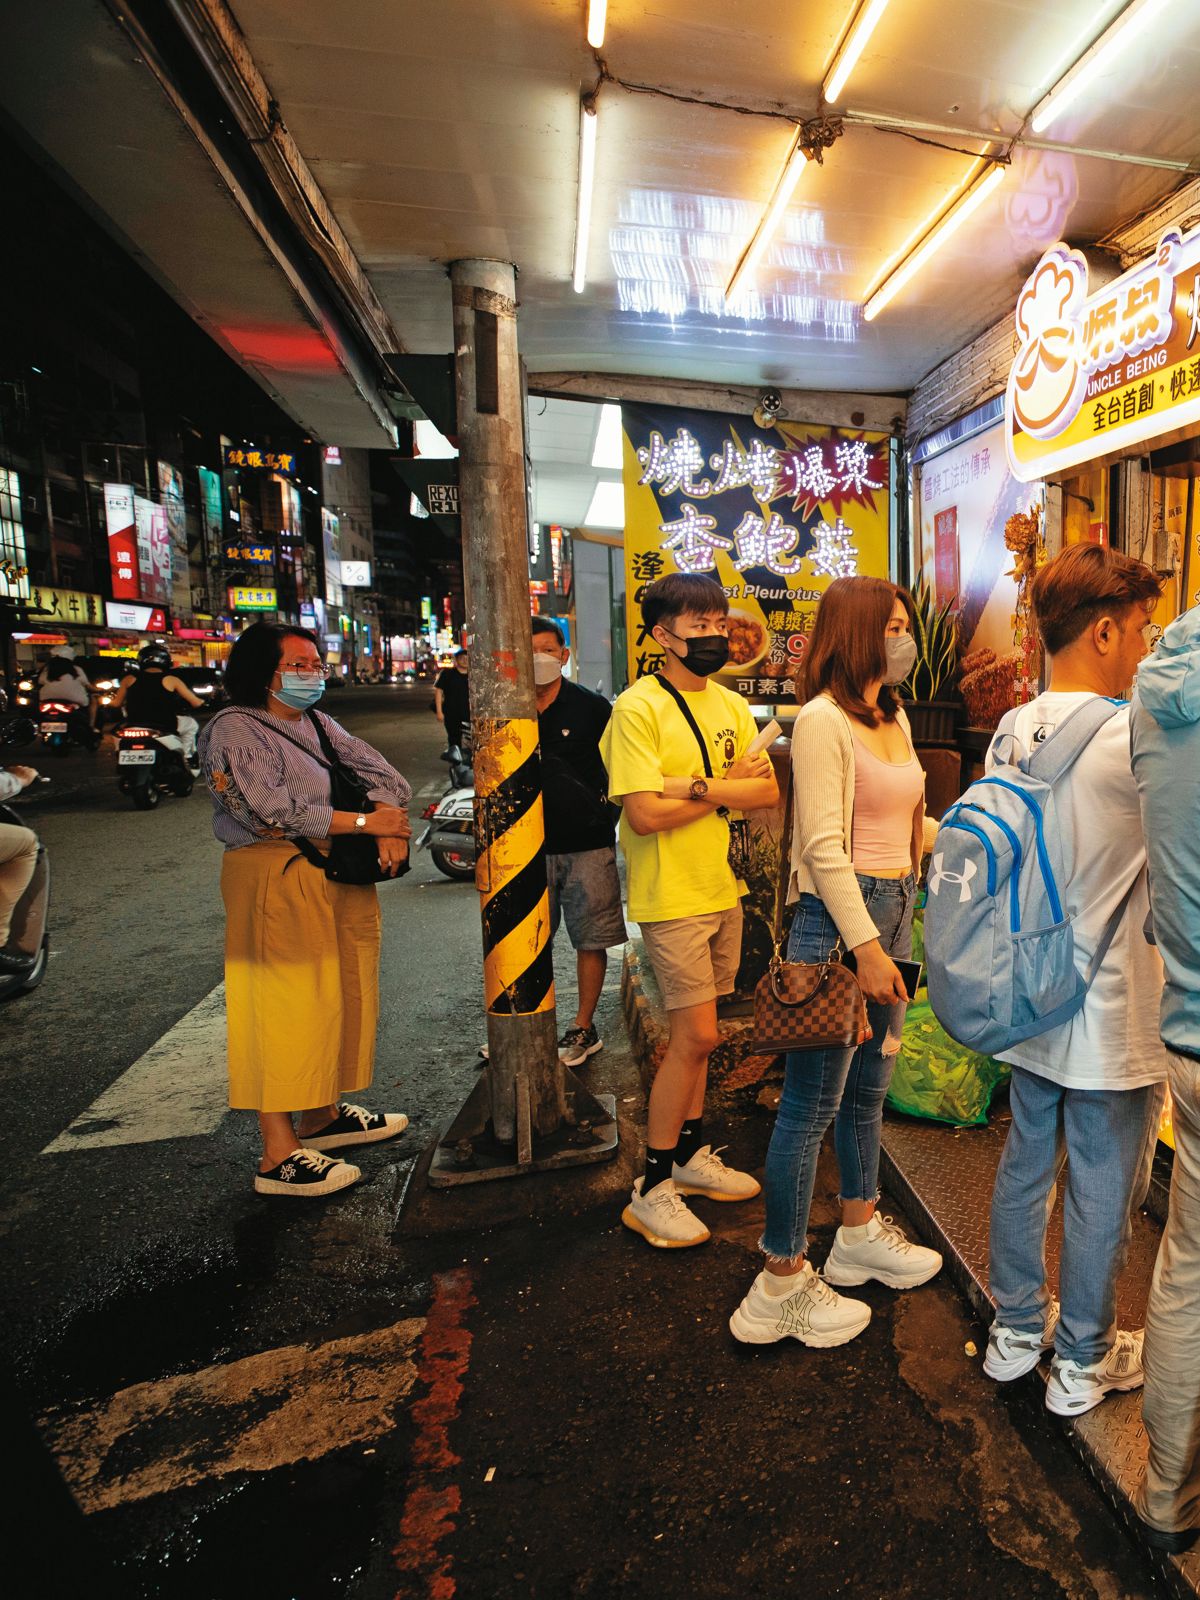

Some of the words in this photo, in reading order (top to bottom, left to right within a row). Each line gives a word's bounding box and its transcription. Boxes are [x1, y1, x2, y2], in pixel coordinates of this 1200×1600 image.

[1087, 371, 1121, 396] UNCLE
[1126, 350, 1167, 379] BEING
[659, 503, 859, 578] 杏鮑菇
[743, 584, 821, 600] Pleurotus
